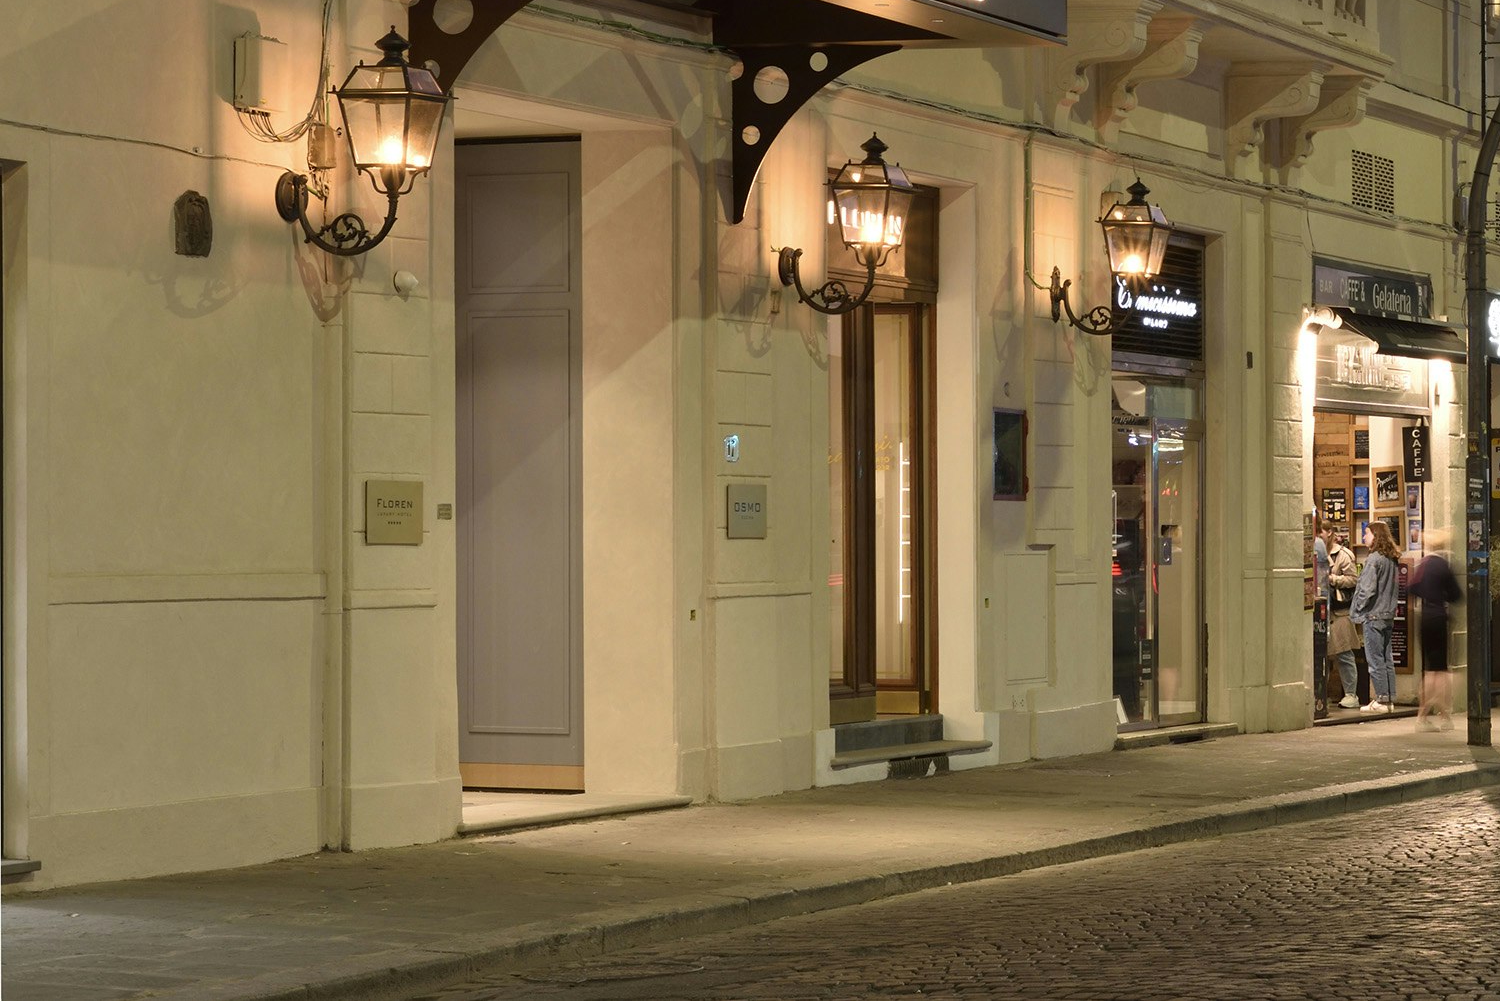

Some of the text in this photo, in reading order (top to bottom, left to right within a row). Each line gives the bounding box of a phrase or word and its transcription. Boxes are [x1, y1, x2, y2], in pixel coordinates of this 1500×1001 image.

[1319, 278, 1333, 294] BAR
[1372, 283, 1412, 315] Gelateria
[1411, 429, 1425, 477] CAFFE'
[376, 498, 414, 509] FLOREN
[734, 502, 761, 513] OSMO
